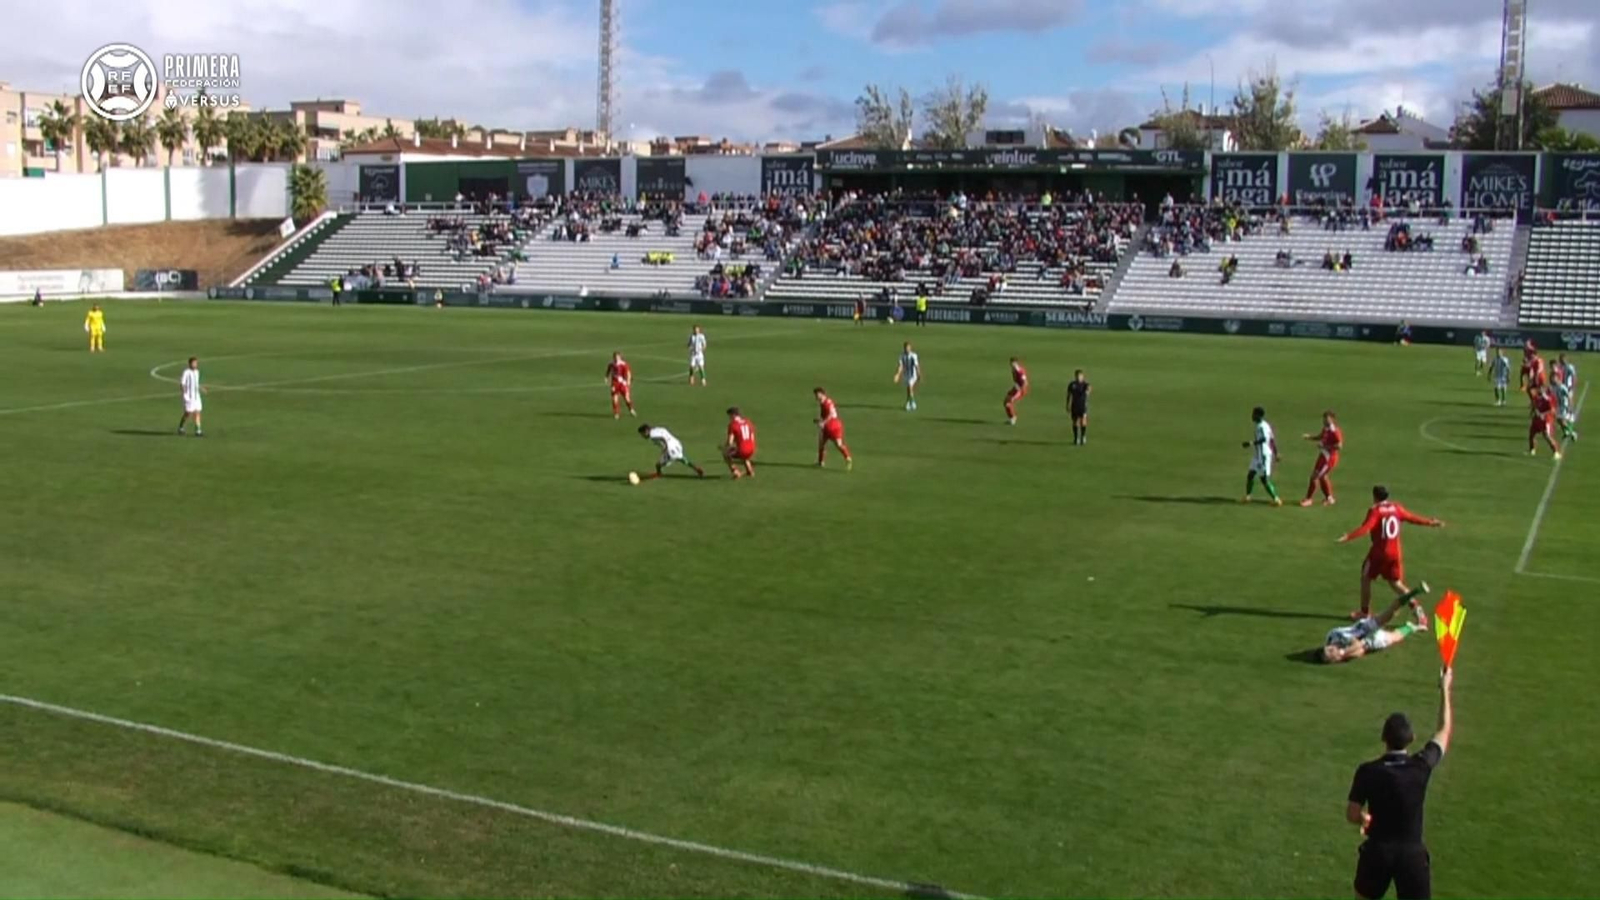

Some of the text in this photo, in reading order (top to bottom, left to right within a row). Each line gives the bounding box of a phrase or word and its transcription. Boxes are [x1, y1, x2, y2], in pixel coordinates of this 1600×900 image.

[1227, 160, 1271, 187] má
[1389, 161, 1437, 189] má
[1468, 175, 1526, 192] MIKE'S
[1463, 191, 1529, 209] HOME
[1381, 515, 1399, 539] 10
